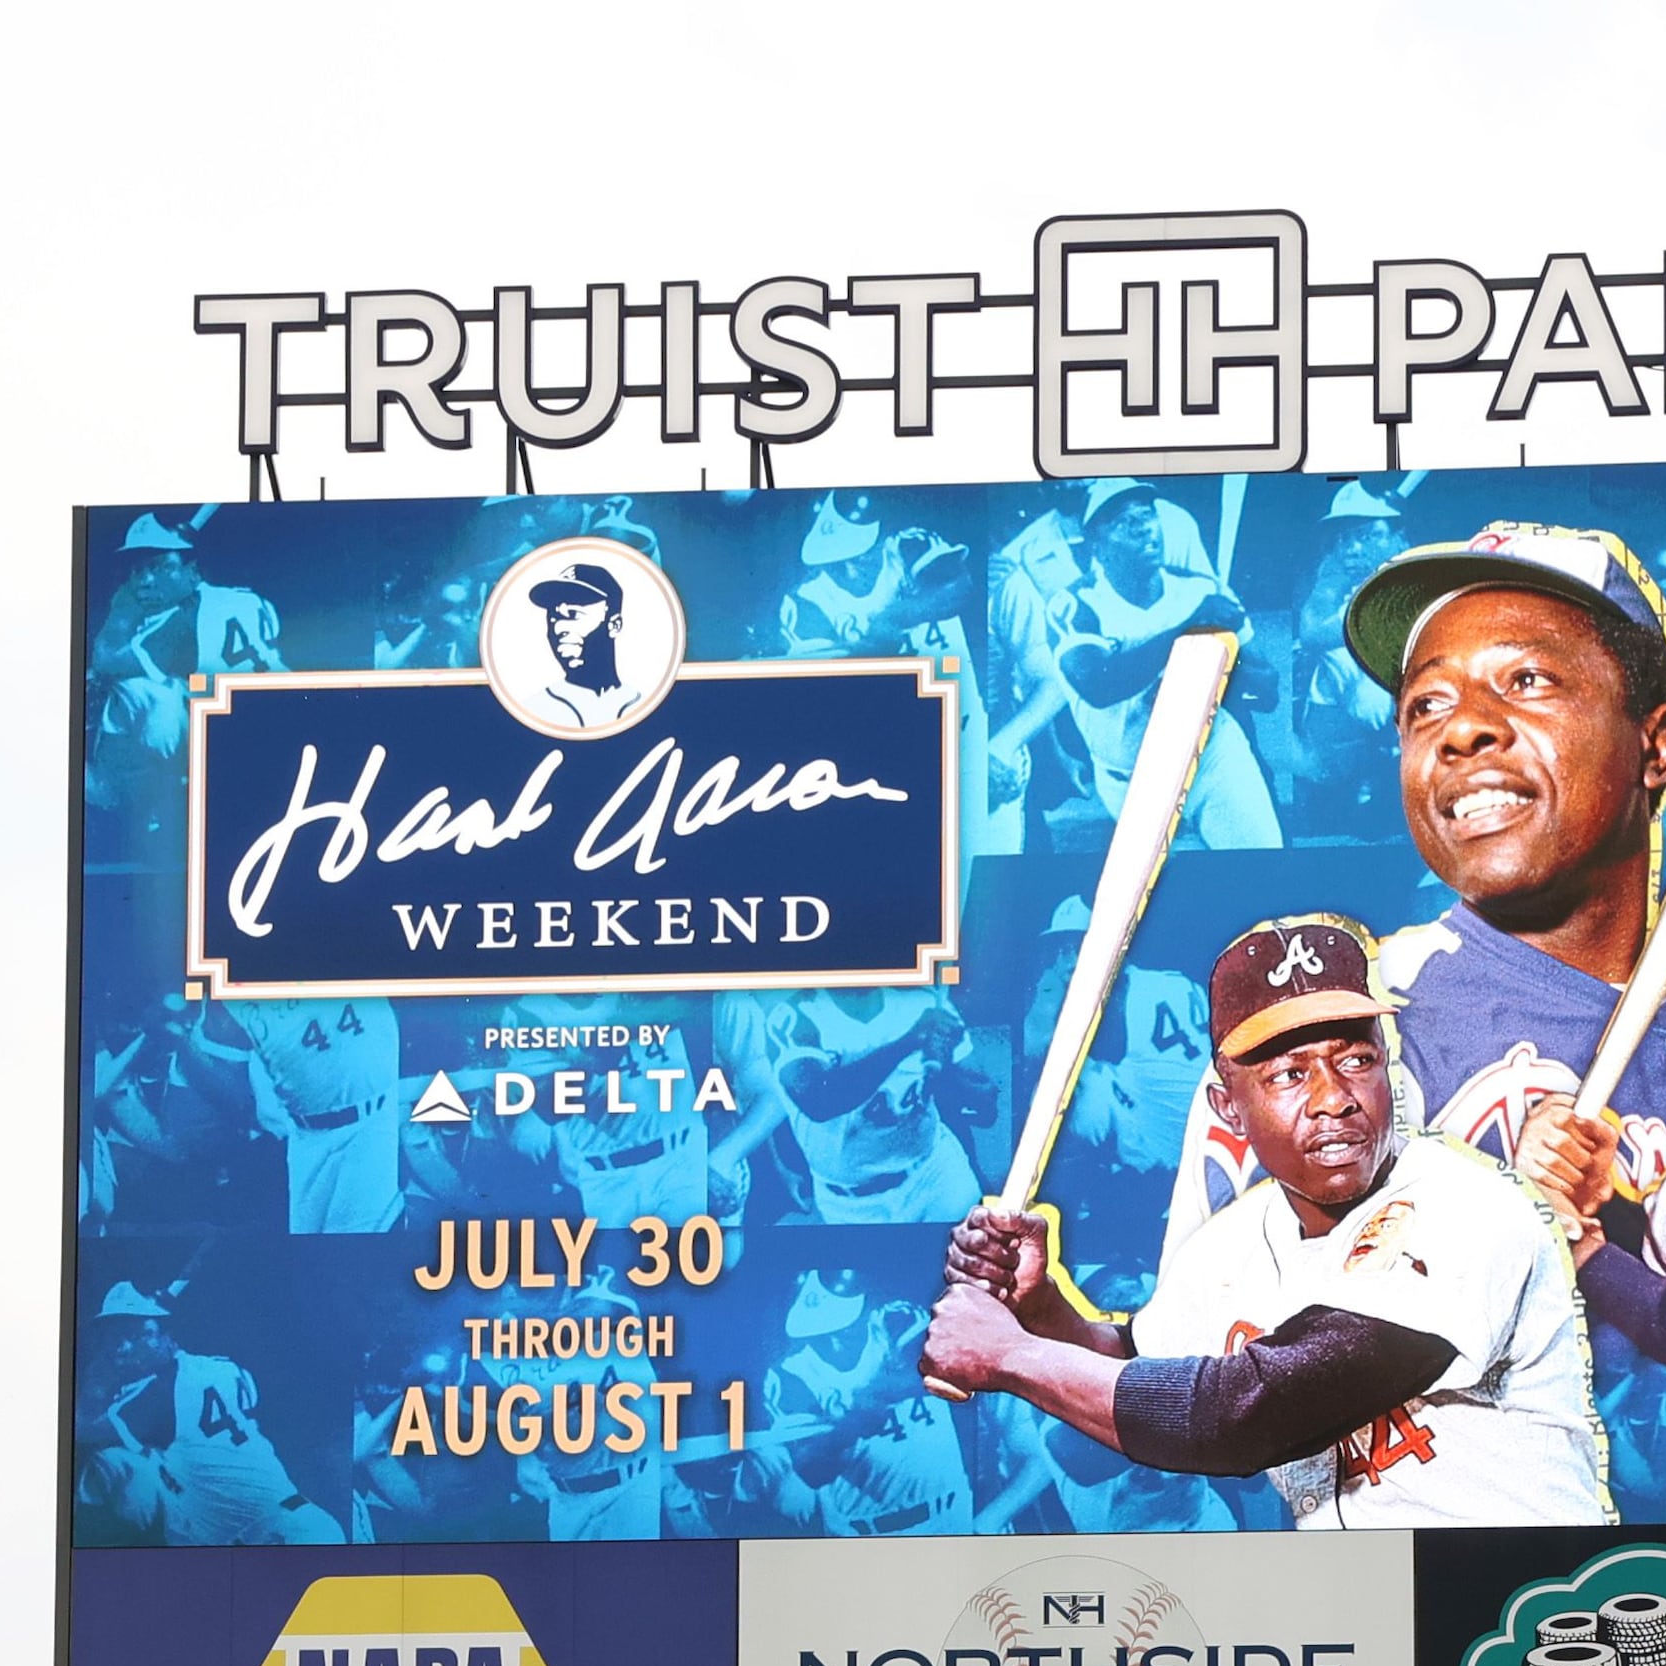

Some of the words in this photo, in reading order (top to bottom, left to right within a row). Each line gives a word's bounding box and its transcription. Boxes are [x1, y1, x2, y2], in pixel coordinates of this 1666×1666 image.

[194, 273, 981, 454] TRUIST
[227, 743, 565, 937] Hank
[573, 736, 909, 874] Aaron
[392, 895, 834, 951] WEEKEND
[1267, 934, 1324, 987] A
[301, 1003, 363, 1051] 44
[483, 1026, 628, 1050] PRESENTED
[636, 1025, 671, 1048] BY
[492, 1067, 738, 1117] DELTA
[412, 1217, 599, 1293] JULY
[625, 1215, 725, 1288] 30
[463, 1315, 676, 1361] THROUGH
[389, 1382, 705, 1458] AUGUST
[717, 1379, 748, 1451] 1
